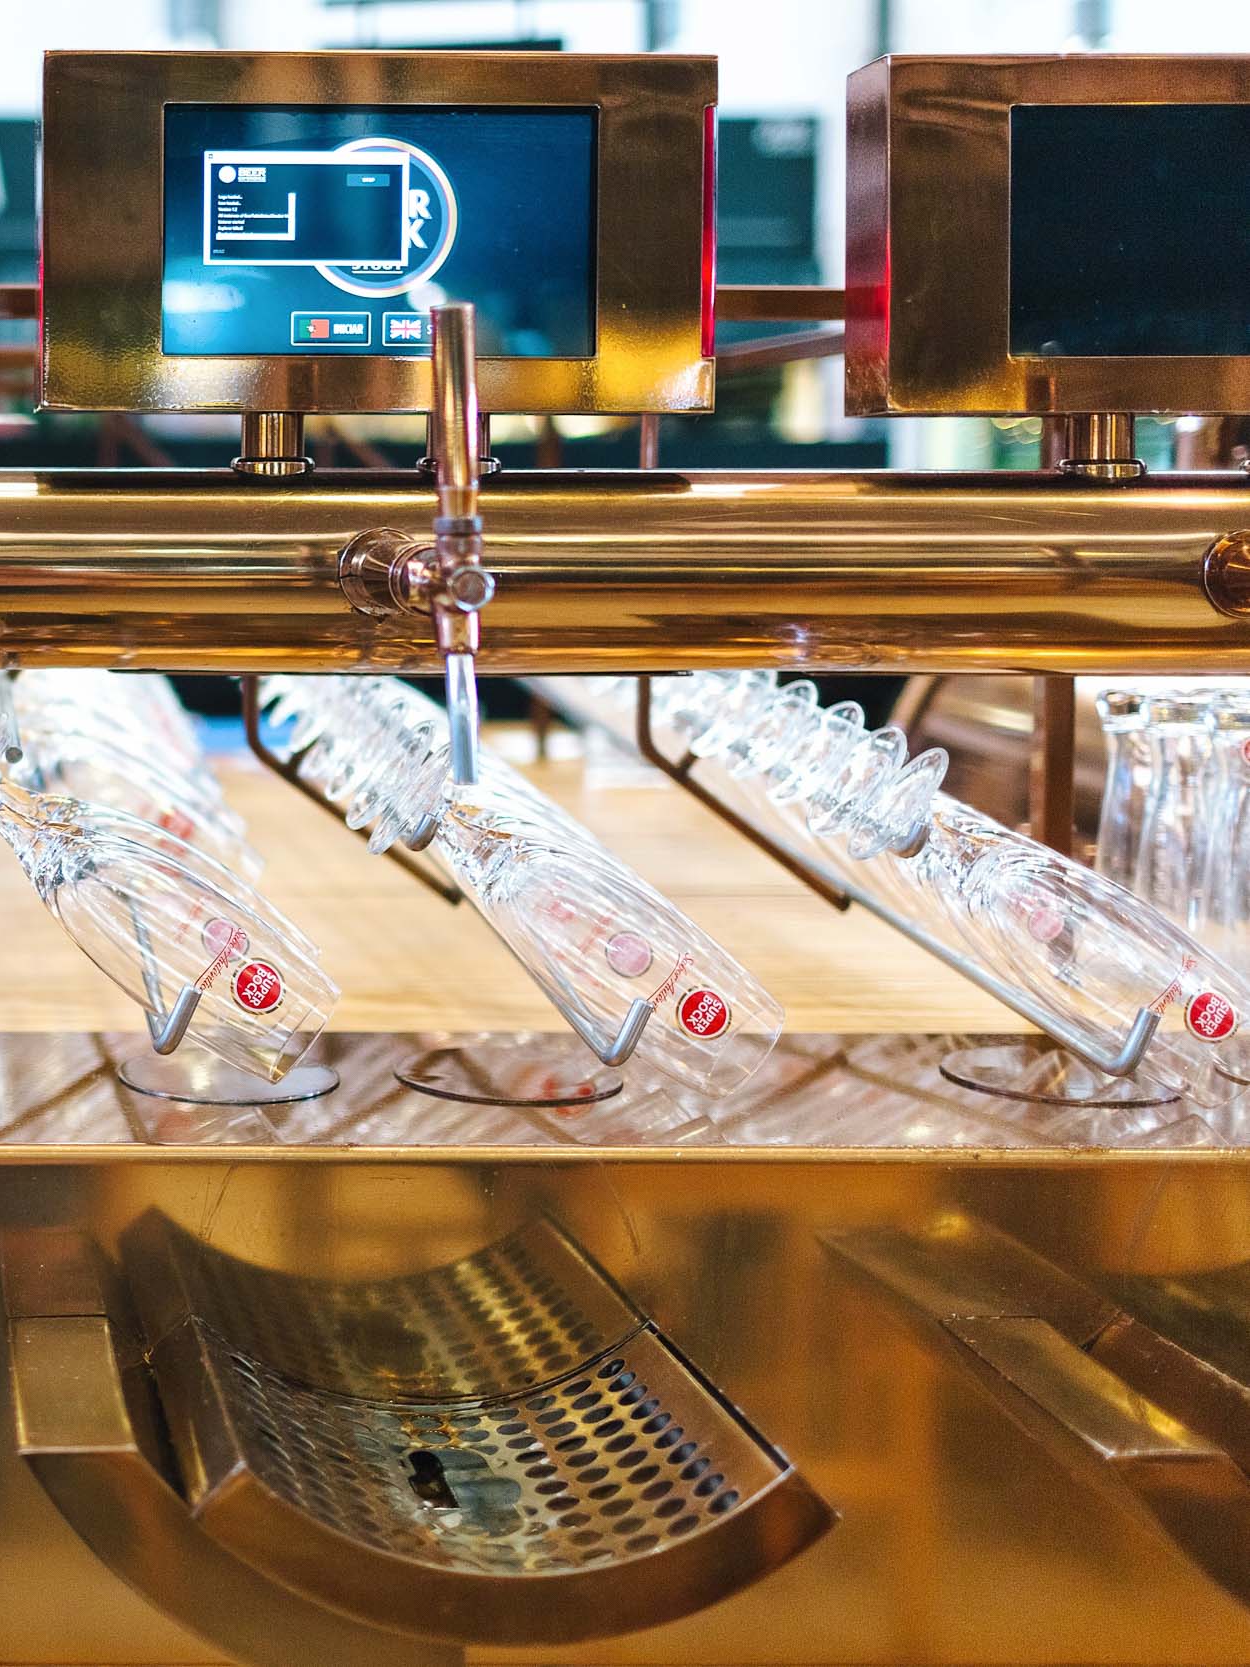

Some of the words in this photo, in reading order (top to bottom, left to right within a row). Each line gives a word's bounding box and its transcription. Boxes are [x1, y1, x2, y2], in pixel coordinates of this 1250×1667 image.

[241, 967, 268, 1001] BOCK
[249, 971, 277, 1007] SUPER
[686, 994, 714, 1026] BOCK
[693, 999, 723, 1033] SUPER
[1194, 995, 1221, 1028] BOCK
[1202, 1000, 1230, 1035] SUPER
